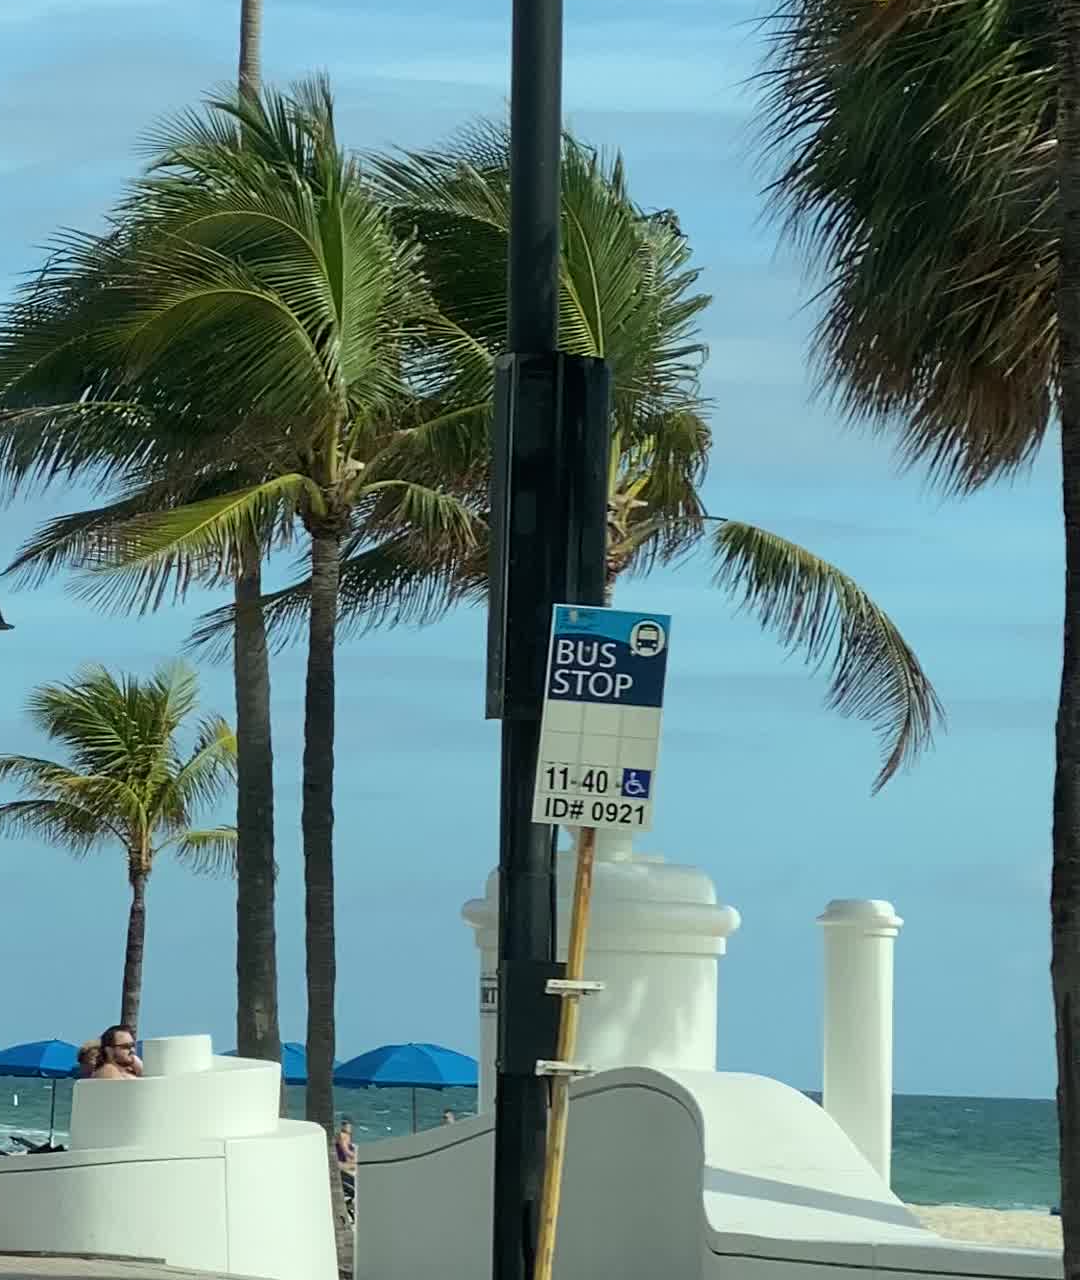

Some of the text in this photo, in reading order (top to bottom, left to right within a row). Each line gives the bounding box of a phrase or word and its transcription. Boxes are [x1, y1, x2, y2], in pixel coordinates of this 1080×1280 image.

[556, 639, 616, 668] BUS
[552, 669, 633, 698] STOP
[545, 797, 644, 825] ID# 0921
